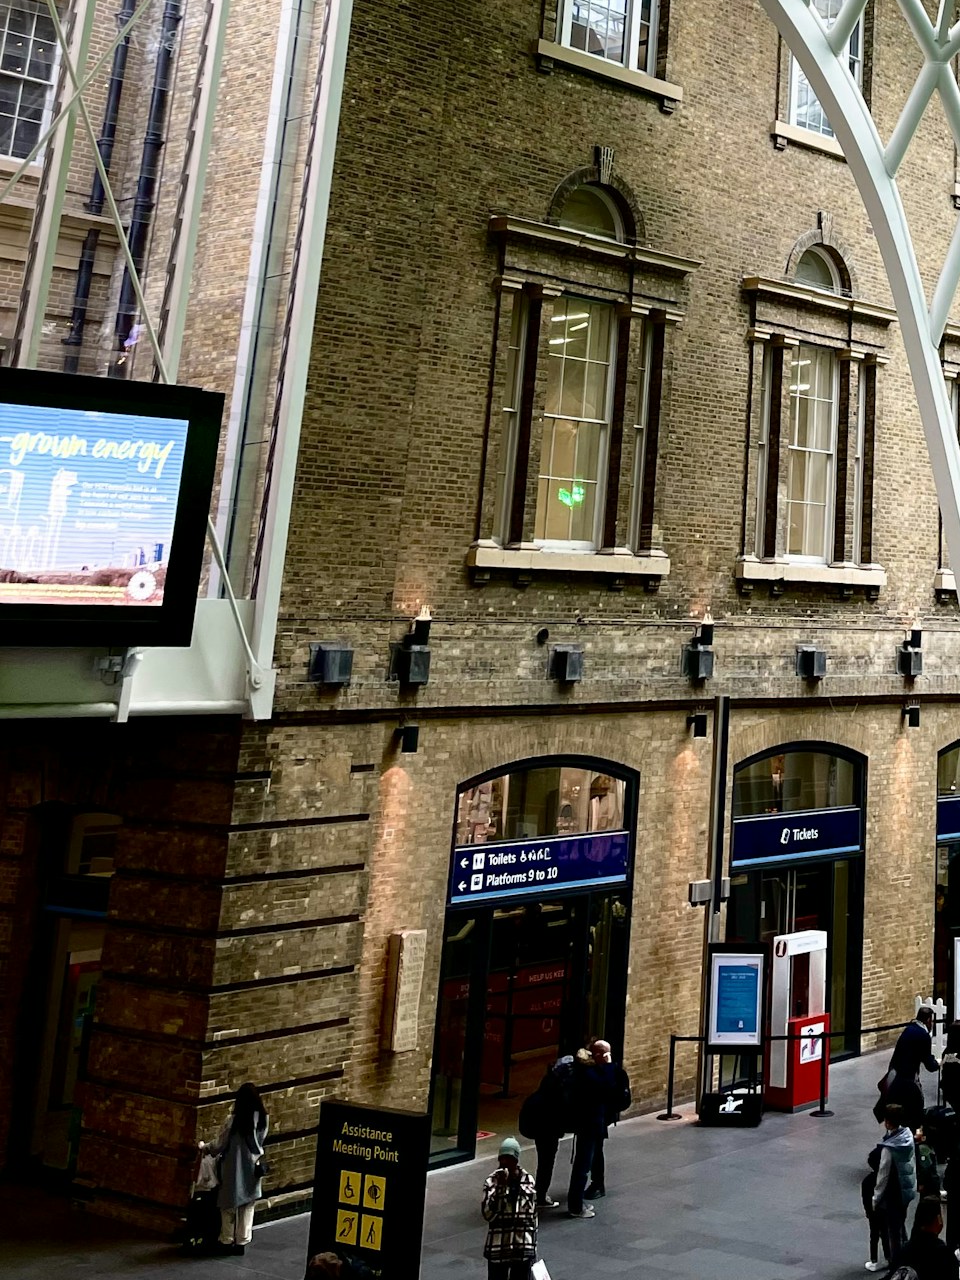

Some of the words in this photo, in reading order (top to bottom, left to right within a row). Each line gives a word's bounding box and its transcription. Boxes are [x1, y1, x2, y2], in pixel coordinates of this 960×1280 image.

[92, 438, 175, 479] energy
[792, 827, 818, 841] Tickets
[488, 853, 516, 866] Toilets
[486, 872, 527, 887] Platforms
[528, 869, 535, 881] 9
[535, 870, 545, 881] to
[547, 867, 558, 880] 10
[341, 1121, 392, 1142] Assistance
[332, 1139, 372, 1161] Meeting
[373, 1145, 399, 1163] Point
